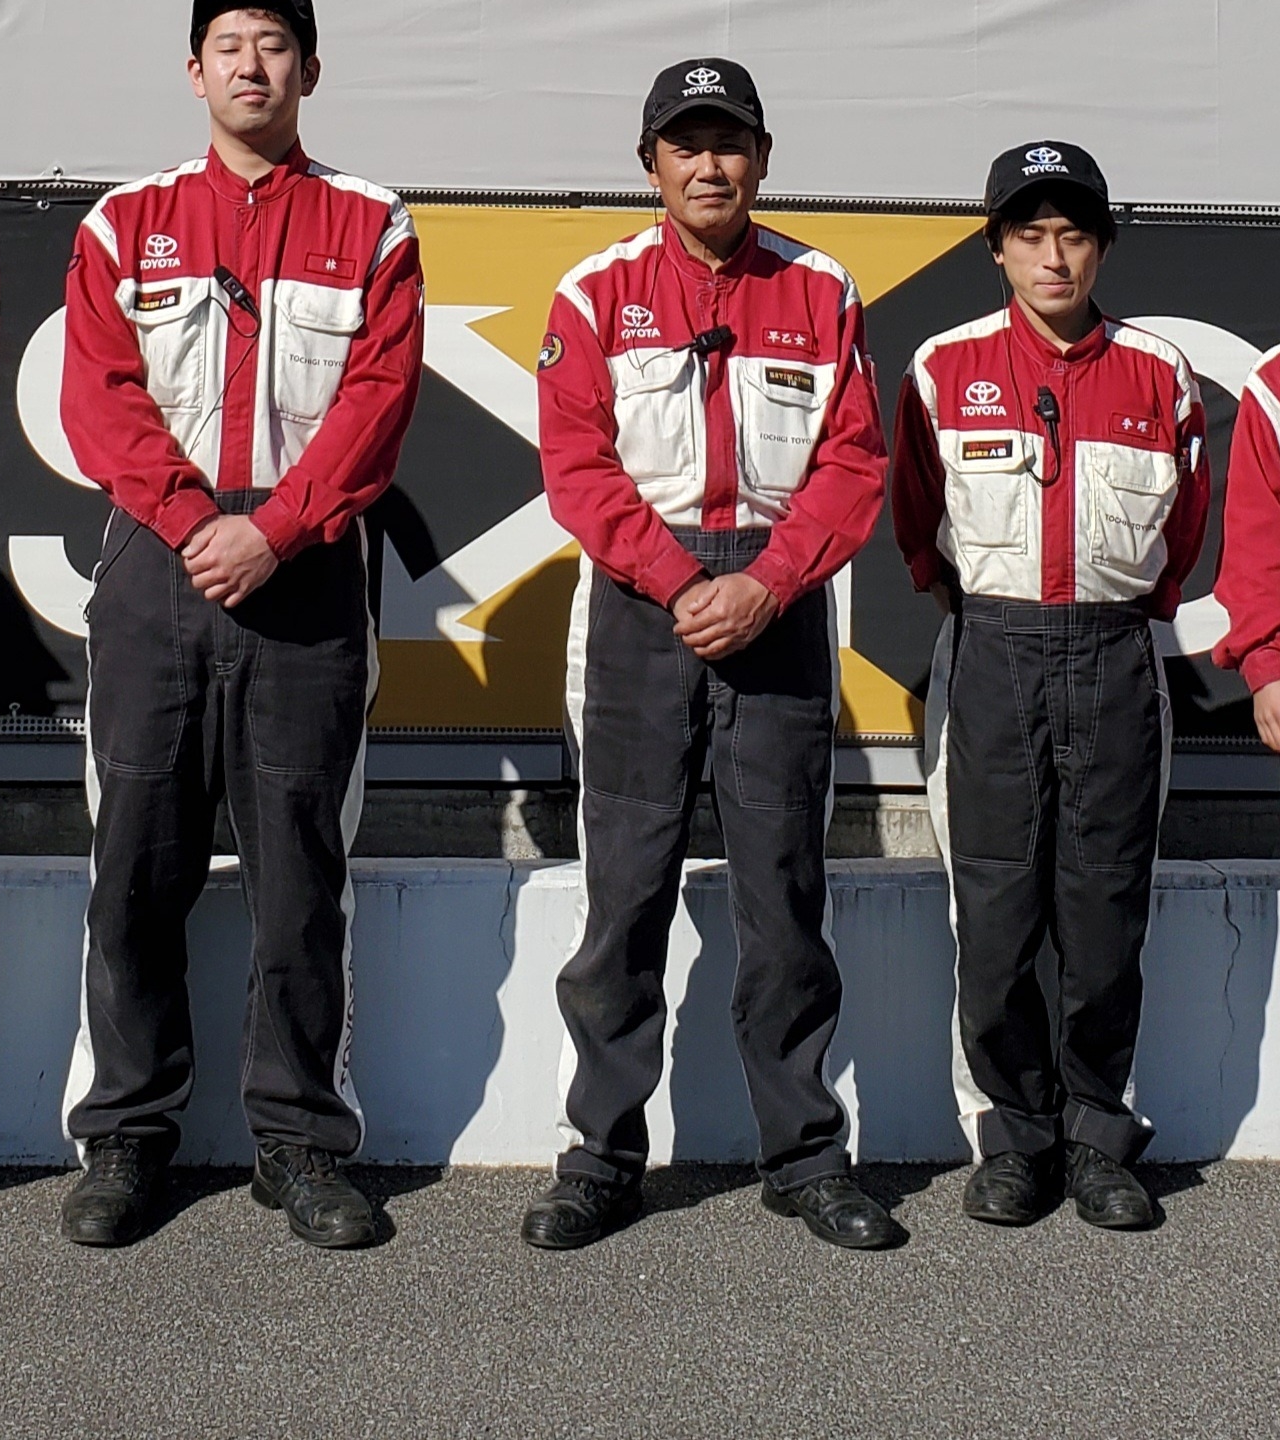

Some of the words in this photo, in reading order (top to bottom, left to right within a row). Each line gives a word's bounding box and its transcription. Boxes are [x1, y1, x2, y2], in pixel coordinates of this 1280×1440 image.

[681, 85, 727, 97] TOYOTA
[1021, 163, 1070, 176] TOYOTA
[138, 257, 181, 270] TOYOTA
[767, 330, 806, 346] 早乙女
[289, 354, 320, 366] TOCHIGI
[323, 359, 345, 368] TOYO
[960, 404, 1007, 417] TOYOTA
[791, 437, 812, 445] TOYO
